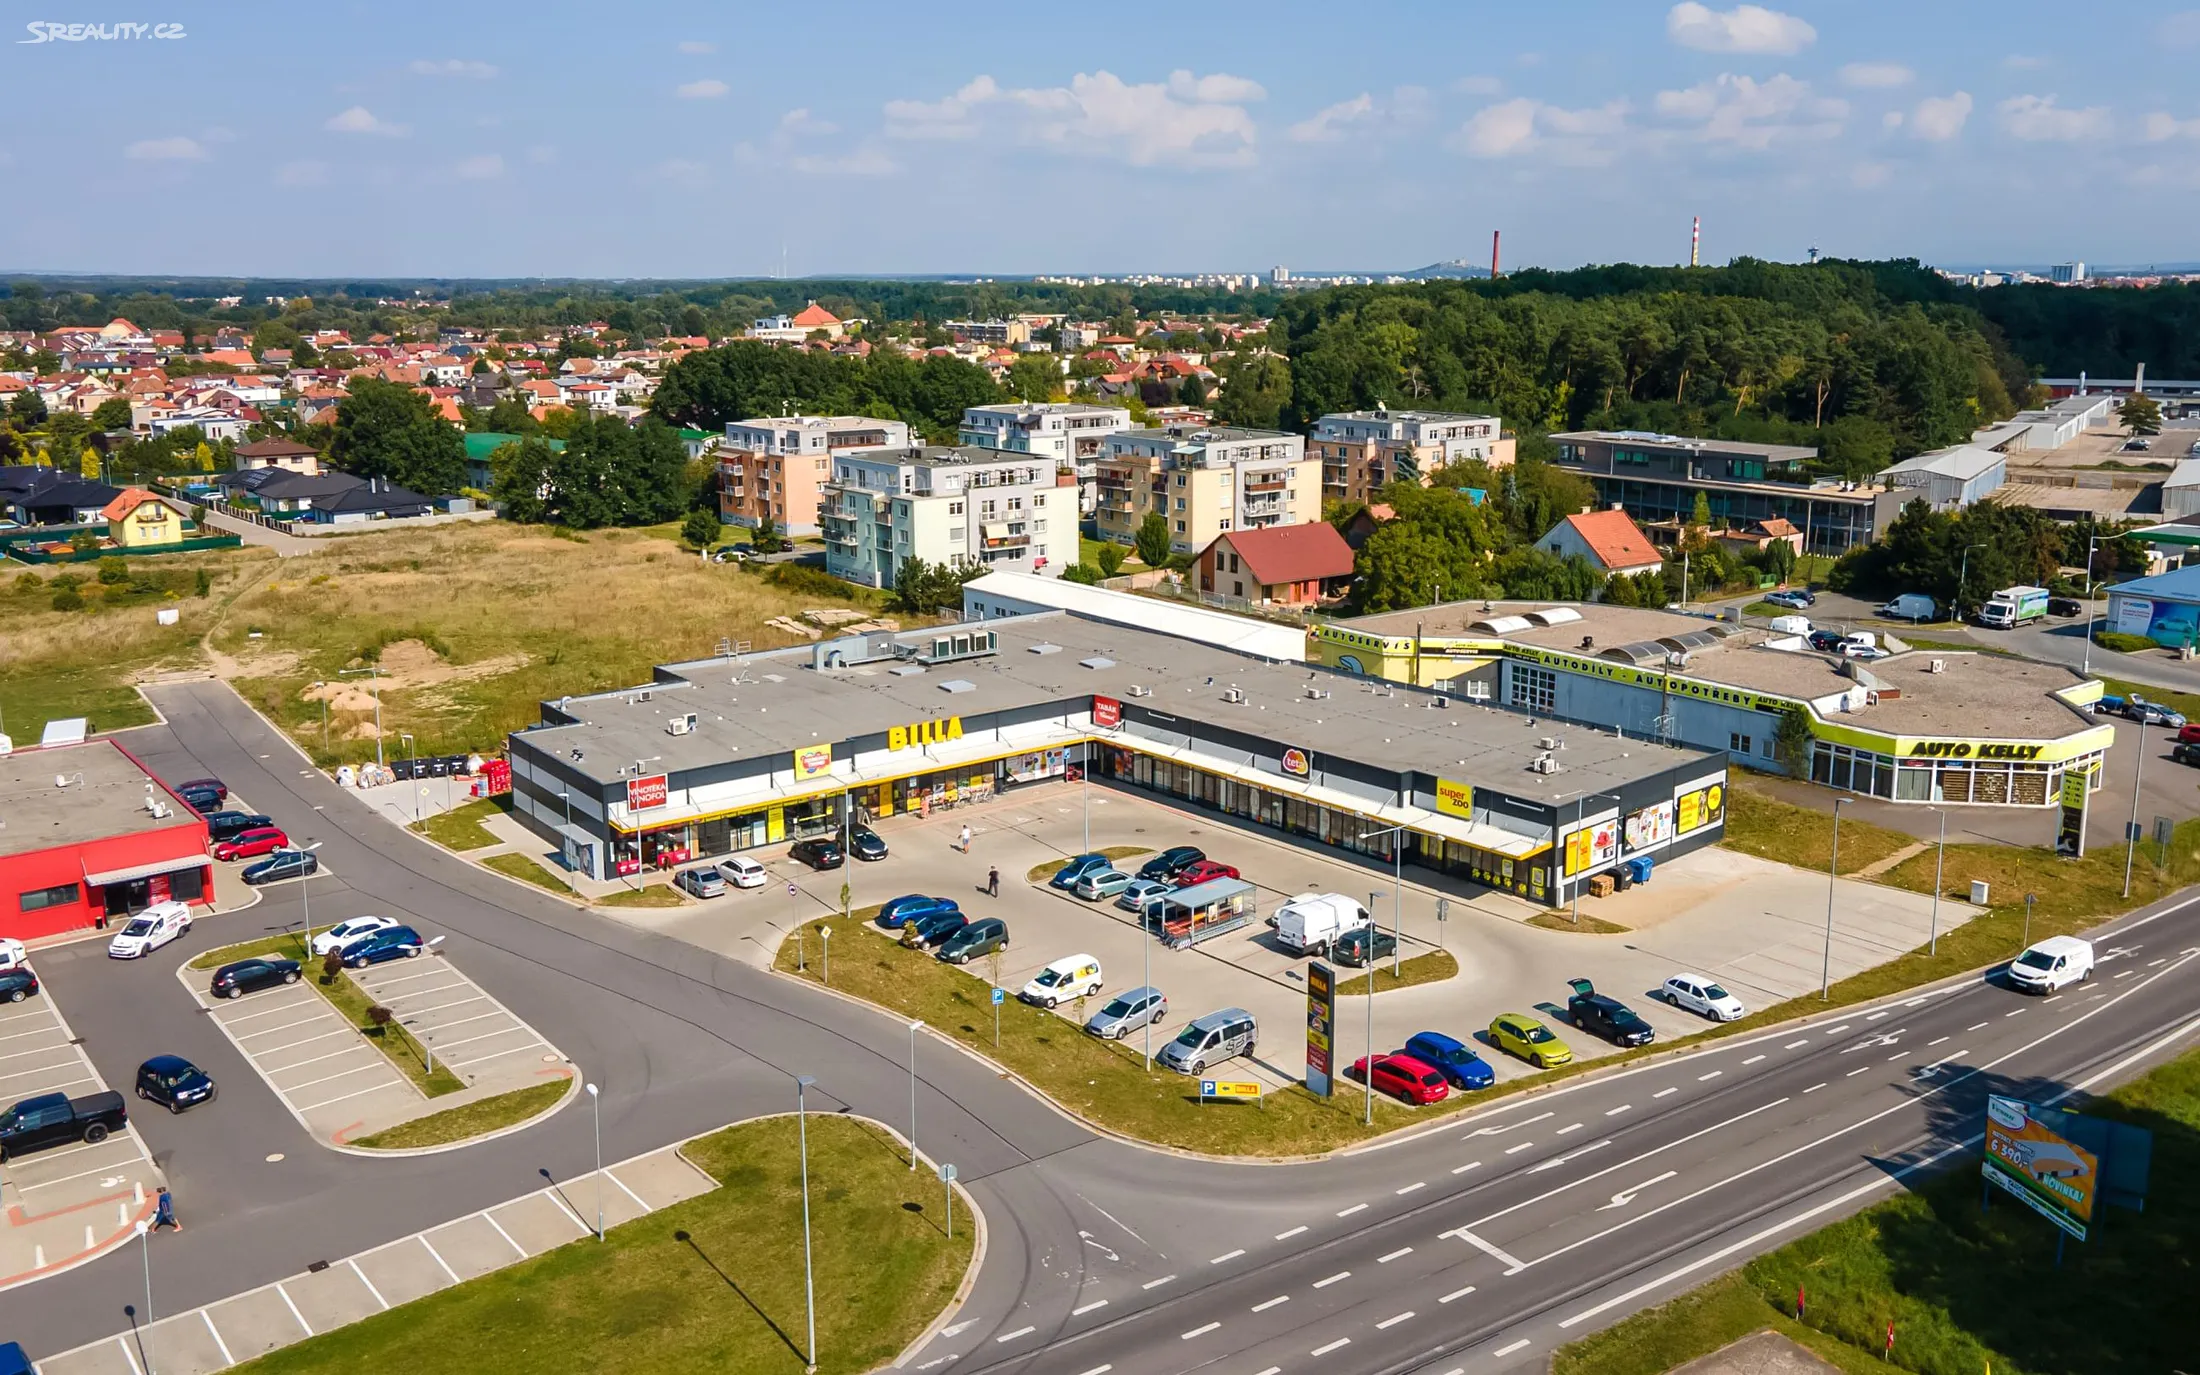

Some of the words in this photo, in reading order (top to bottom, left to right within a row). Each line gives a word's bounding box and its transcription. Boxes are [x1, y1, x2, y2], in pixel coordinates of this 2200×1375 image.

[1323, 629, 1410, 651] AUTOSERVIS
[1543, 655, 1615, 677] AUTODÍLY
[1635, 674, 1752, 706] AUTOPOTŘEBY
[1757, 696, 1778, 706] AUTO
[888, 715, 964, 752] BILLA
[1909, 741, 1972, 757] AUTO
[1976, 743, 2044, 759] KELLY
[1286, 756, 1305, 769] teta
[630, 791, 666, 804] VNOFOL
[1439, 787, 1466, 800] super
[1452, 798, 1469, 809] zoo
[1204, 1082, 1214, 1094] P
[1990, 1139, 1999, 1151] 6
[2042, 1173, 2085, 1204] NOVINKA!
